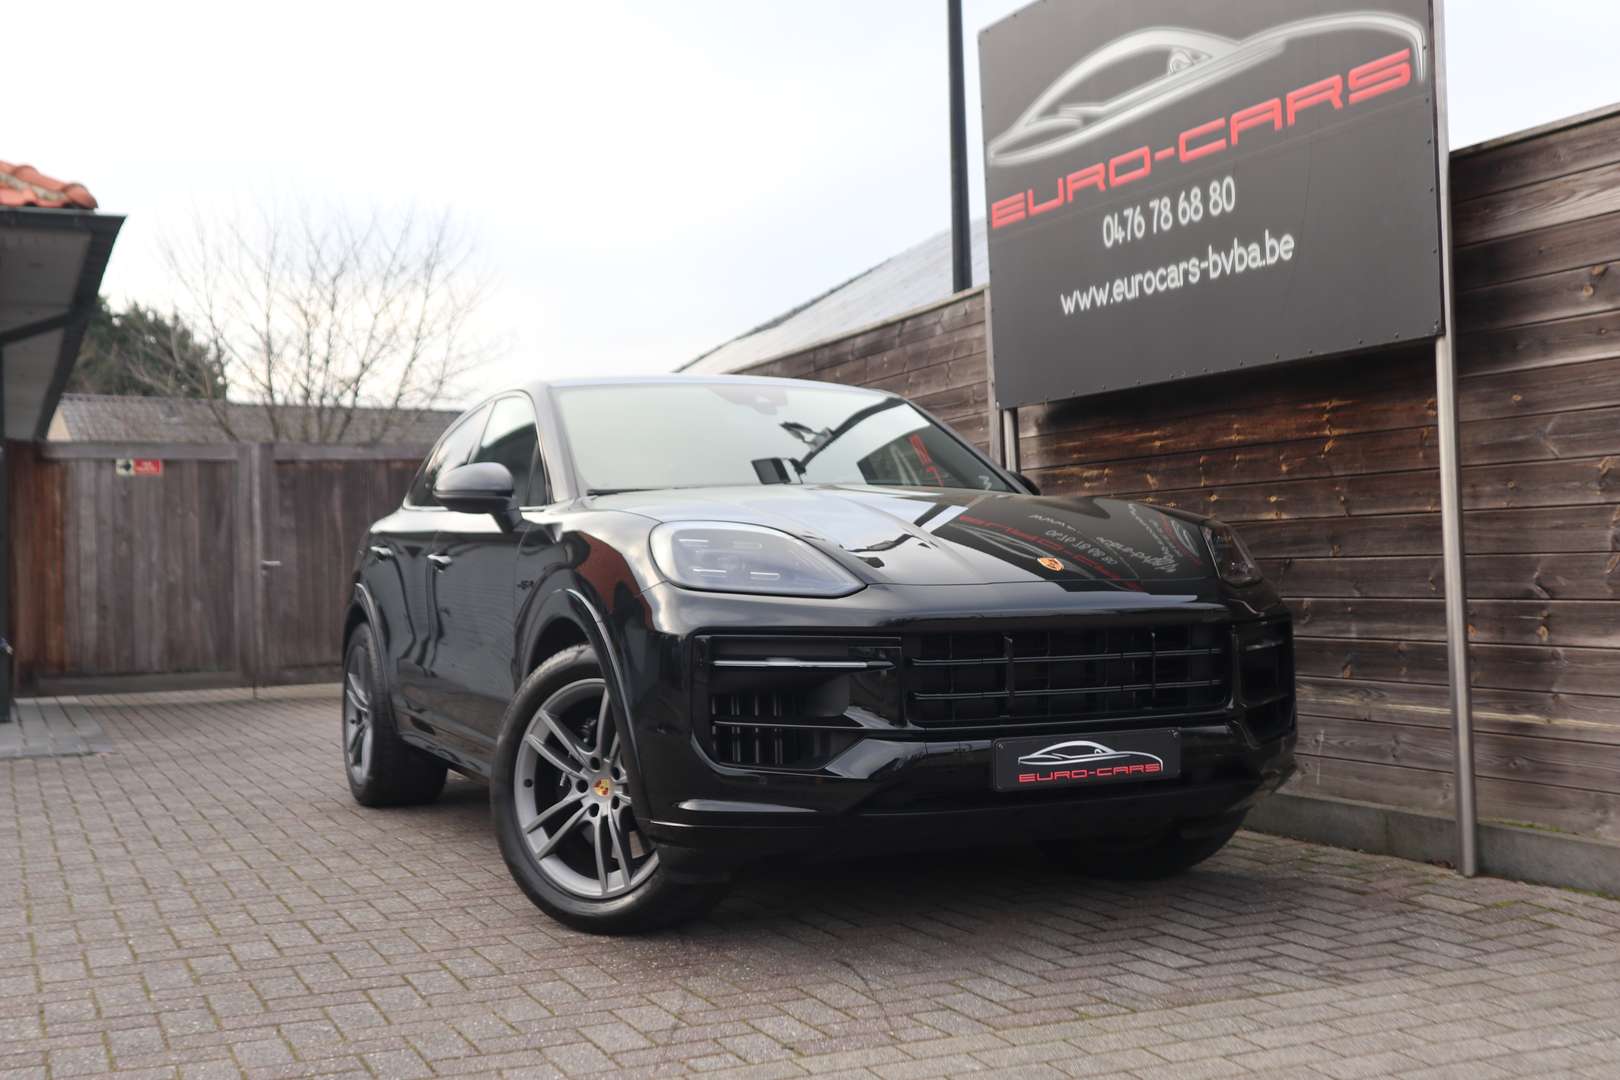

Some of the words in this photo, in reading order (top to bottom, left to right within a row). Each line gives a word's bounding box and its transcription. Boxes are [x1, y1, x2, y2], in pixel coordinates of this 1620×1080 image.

[991, 47, 1412, 229] EURO-CARS
[1102, 204, 1146, 249] 0476
[1149, 195, 1174, 234] 78
[1177, 186, 1204, 226] 68
[1208, 175, 1236, 217] 80
[1060, 229, 1295, 315] www.eurocars-bvba.be
[1018, 763, 1161, 783] EURO-CARS
